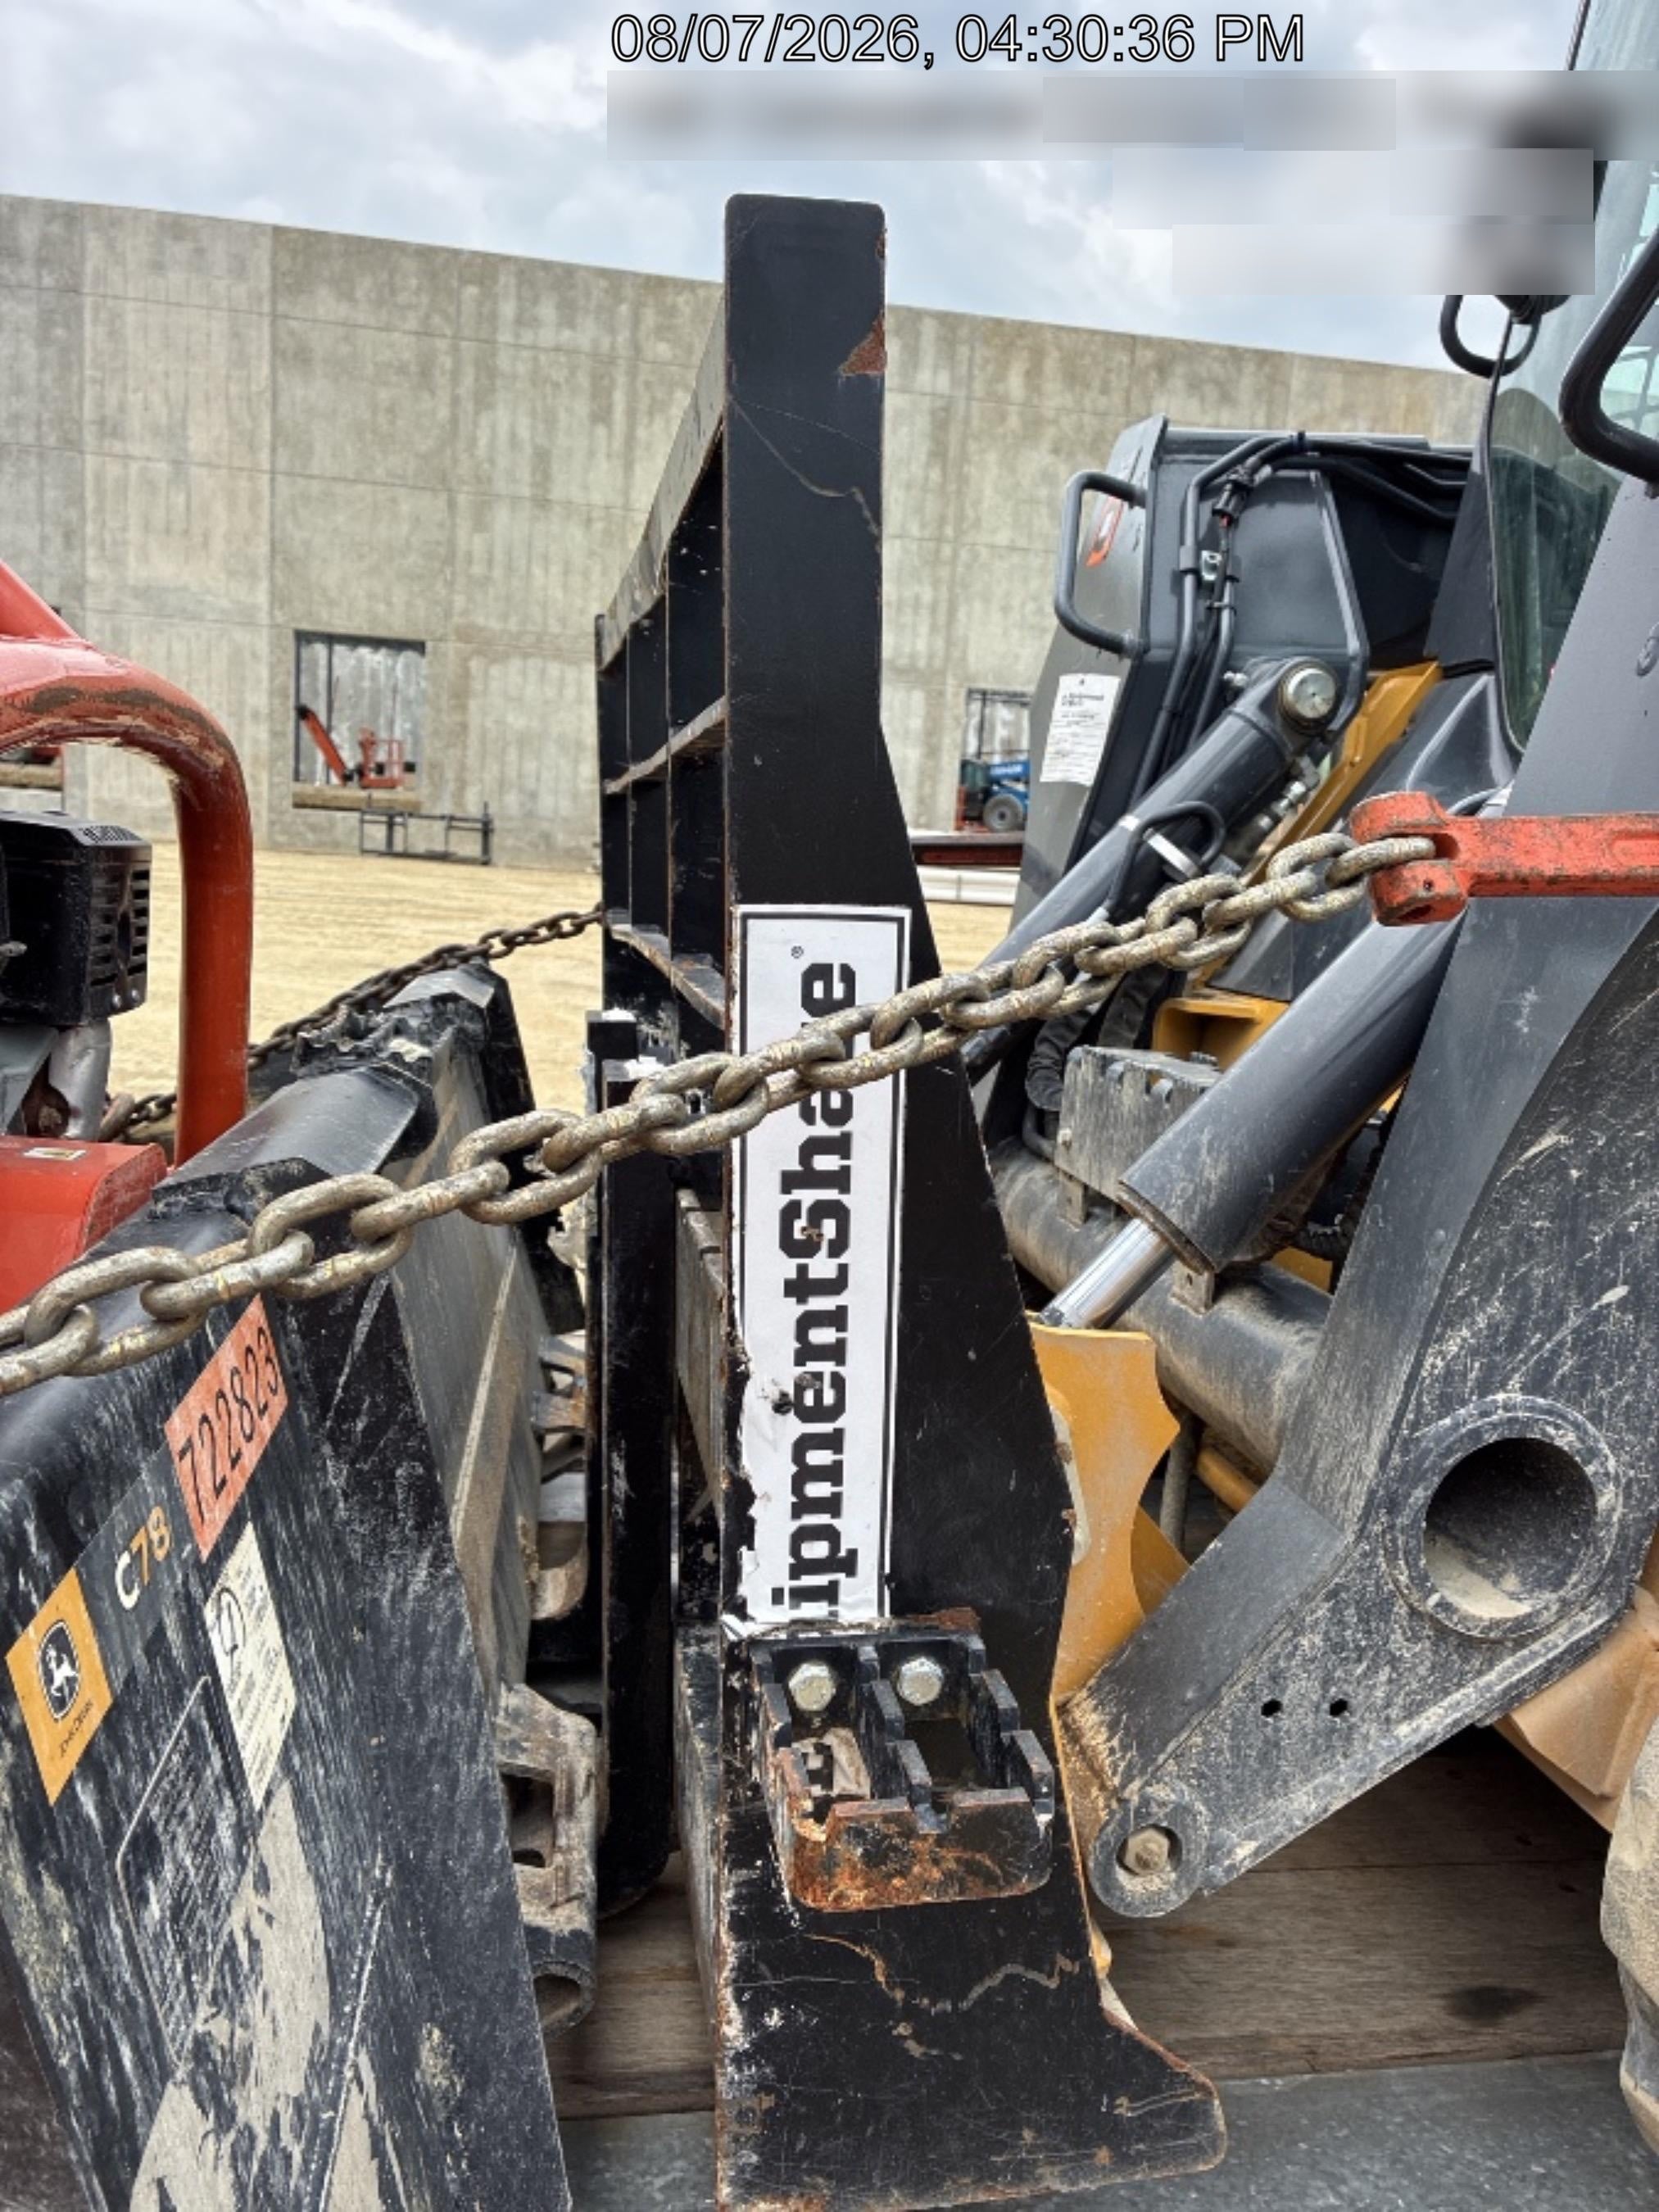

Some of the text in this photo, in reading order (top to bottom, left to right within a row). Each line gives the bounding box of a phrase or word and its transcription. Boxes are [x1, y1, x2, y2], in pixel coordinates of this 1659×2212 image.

[772, 963, 858, 1619] ipmentShae
[179, 1326, 279, 1525] 722823
[115, 1506, 171, 1611] C78
